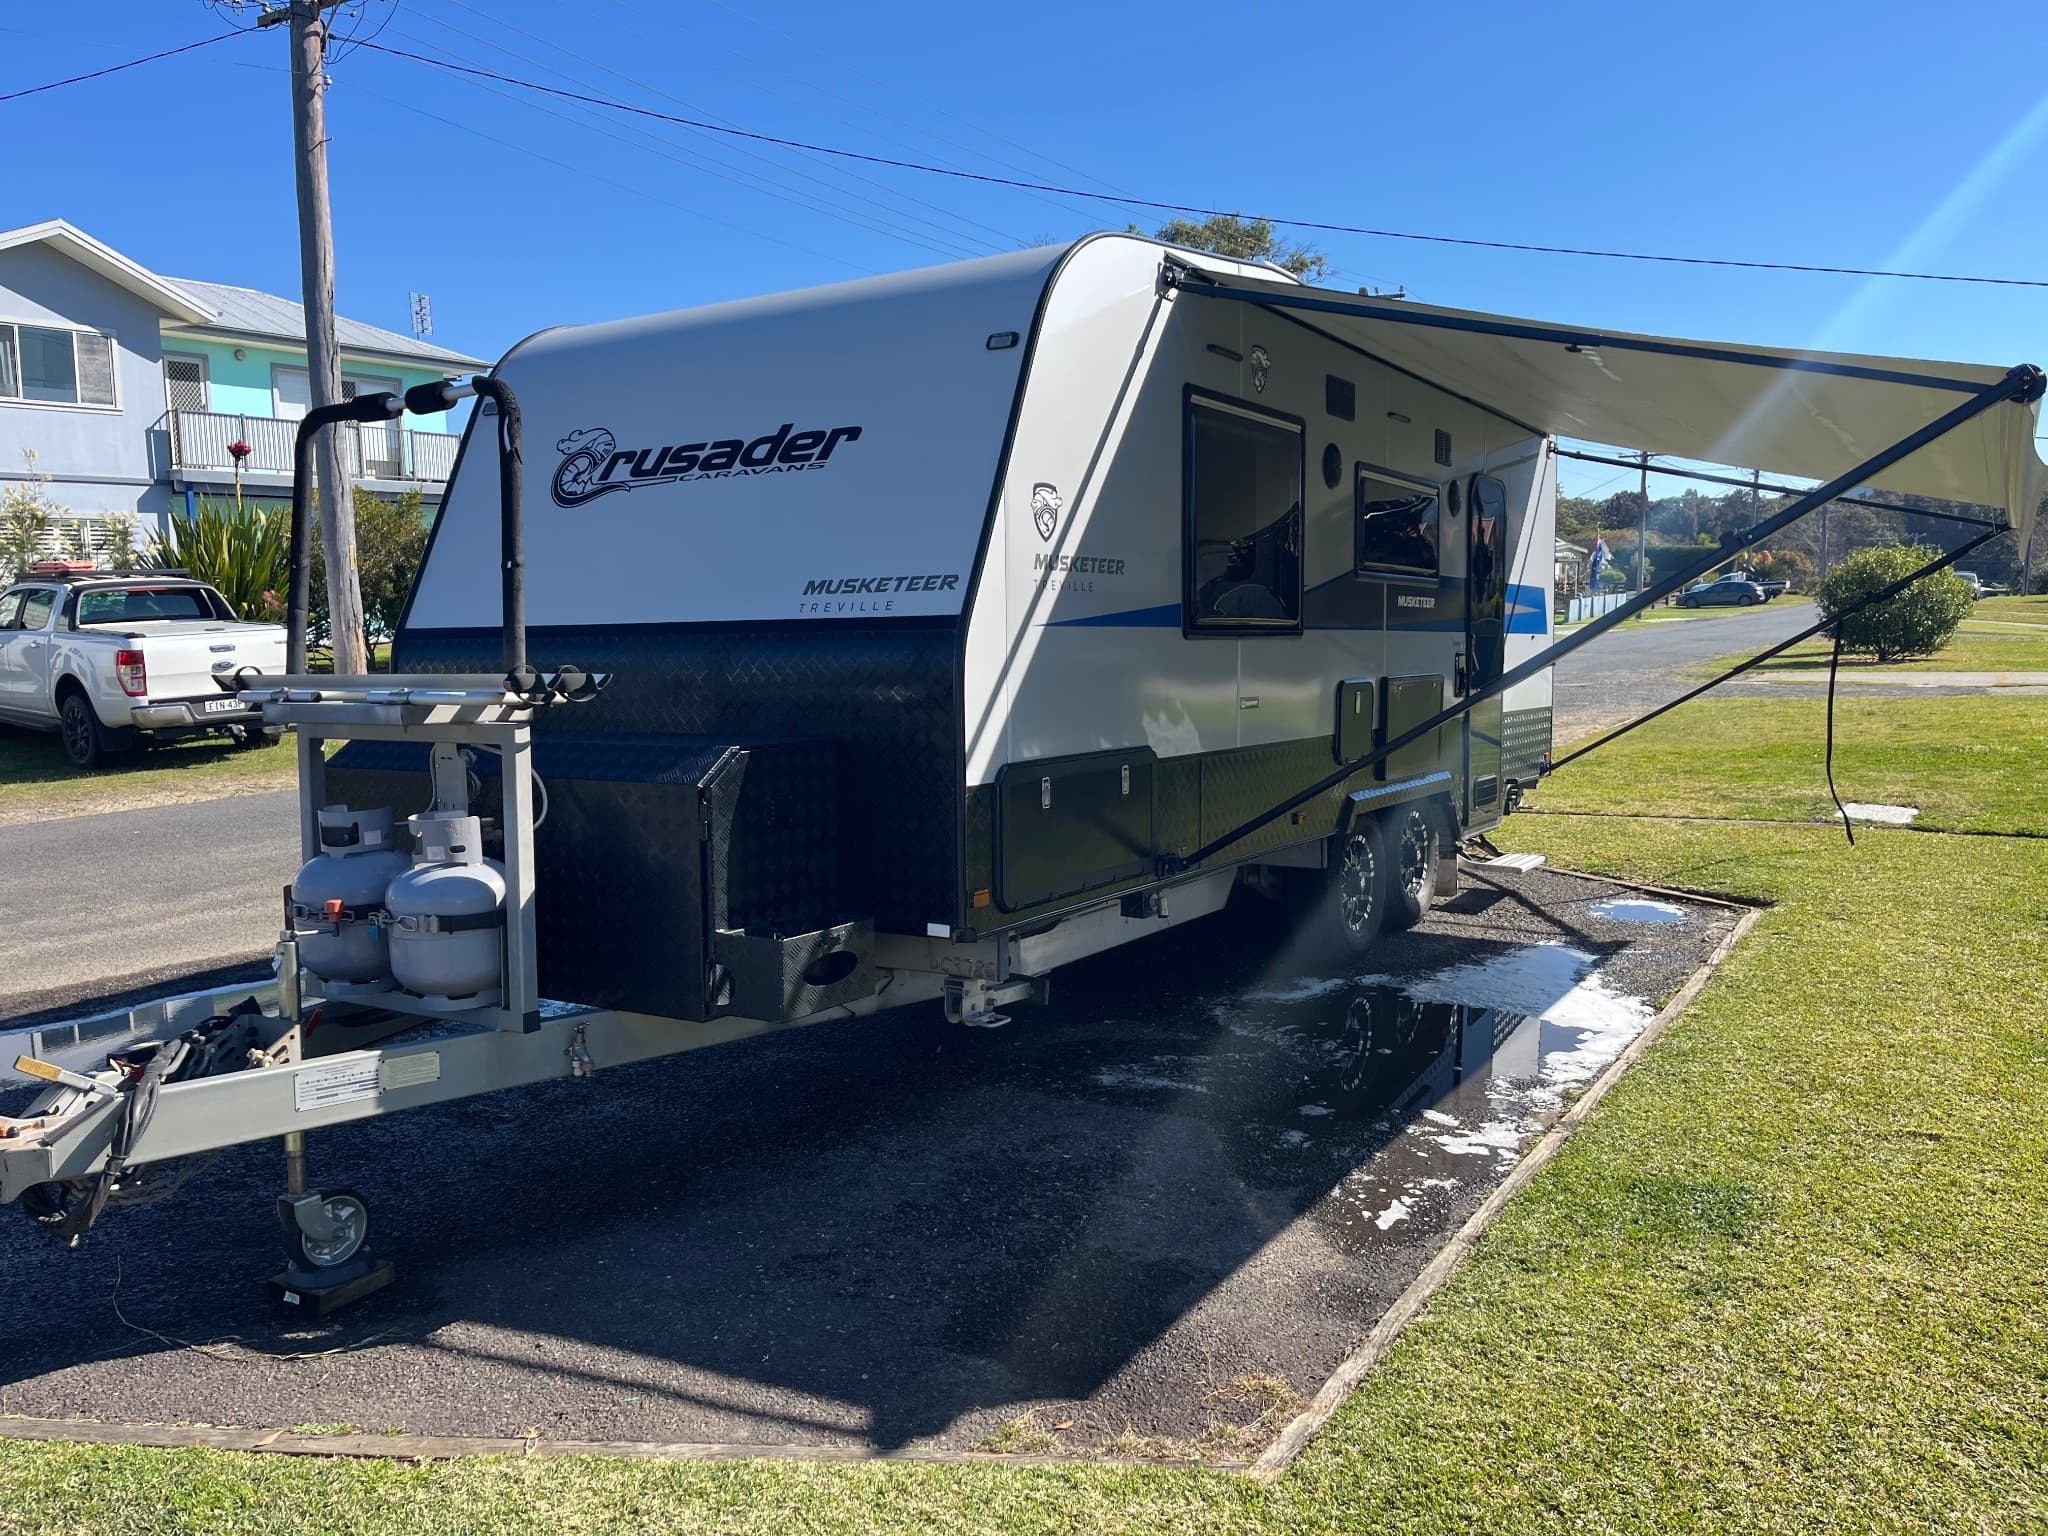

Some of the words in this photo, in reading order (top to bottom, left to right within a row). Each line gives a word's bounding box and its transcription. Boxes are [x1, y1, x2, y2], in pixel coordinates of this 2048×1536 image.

[678, 461, 827, 482] CARAVANS
[1033, 553, 1126, 576] MUSKETEER
[803, 574, 960, 596] MUSKETEER
[1033, 579, 1096, 593] TREVILLE
[799, 600, 896, 614] TREVILLE
[1397, 595, 1436, 609] MUSKETEER
